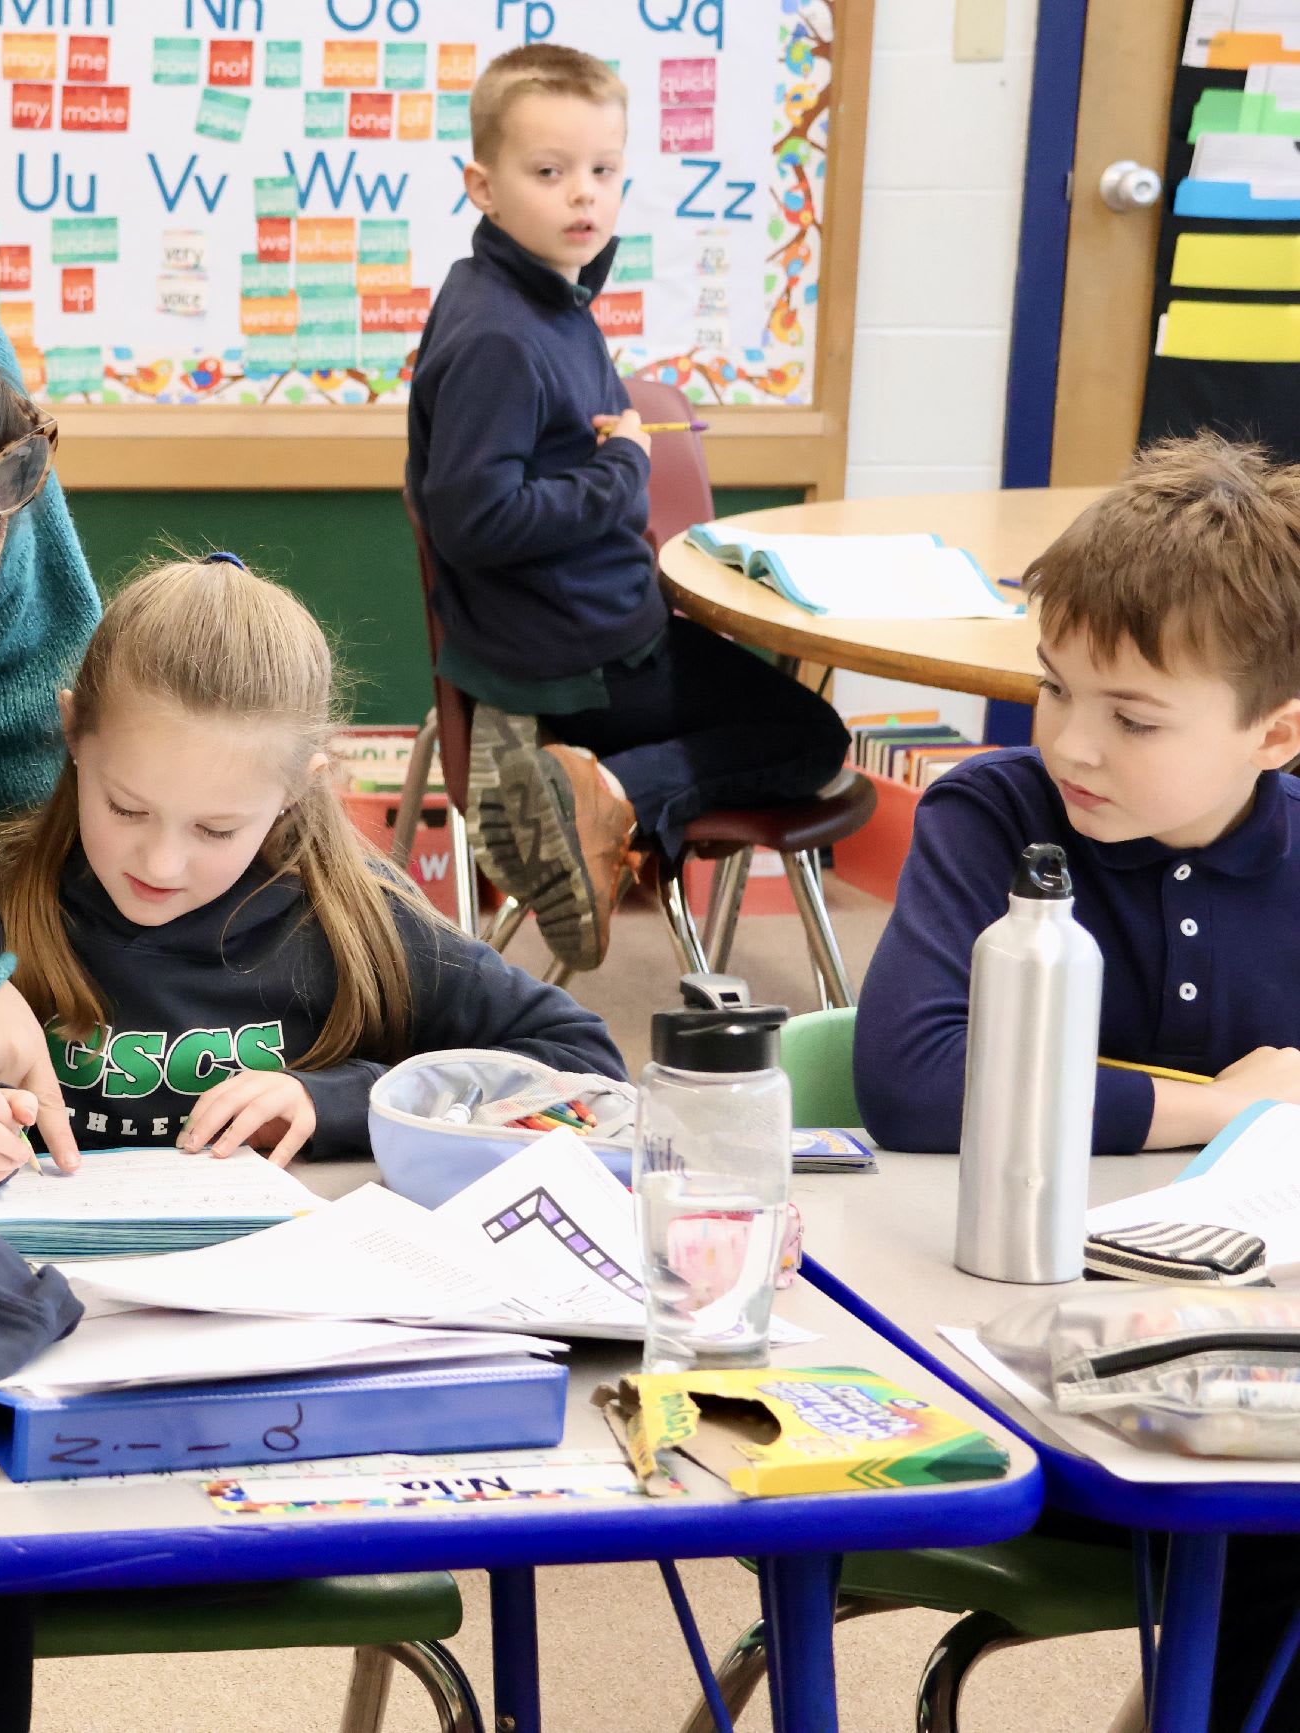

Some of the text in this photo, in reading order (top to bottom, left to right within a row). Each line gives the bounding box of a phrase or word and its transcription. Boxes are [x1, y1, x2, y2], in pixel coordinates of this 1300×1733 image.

[4, 50, 53, 76] may
[71, 53, 106, 70] me
[213, 55, 249, 77] not
[661, 64, 716, 104] quick
[14, 102, 50, 128] my
[64, 96, 126, 123] make
[352, 112, 390, 130] one
[403, 101, 429, 127] of
[18, 153, 95, 212] Uu
[148, 153, 228, 213] Vv
[283, 151, 409, 213] Ww
[676, 159, 756, 220] Zz
[259, 236, 290, 251] we
[165, 247, 204, 269] very
[66, 284, 93, 312] up
[363, 297, 429, 325] where
[45, 1014, 287, 1099] GSCS
